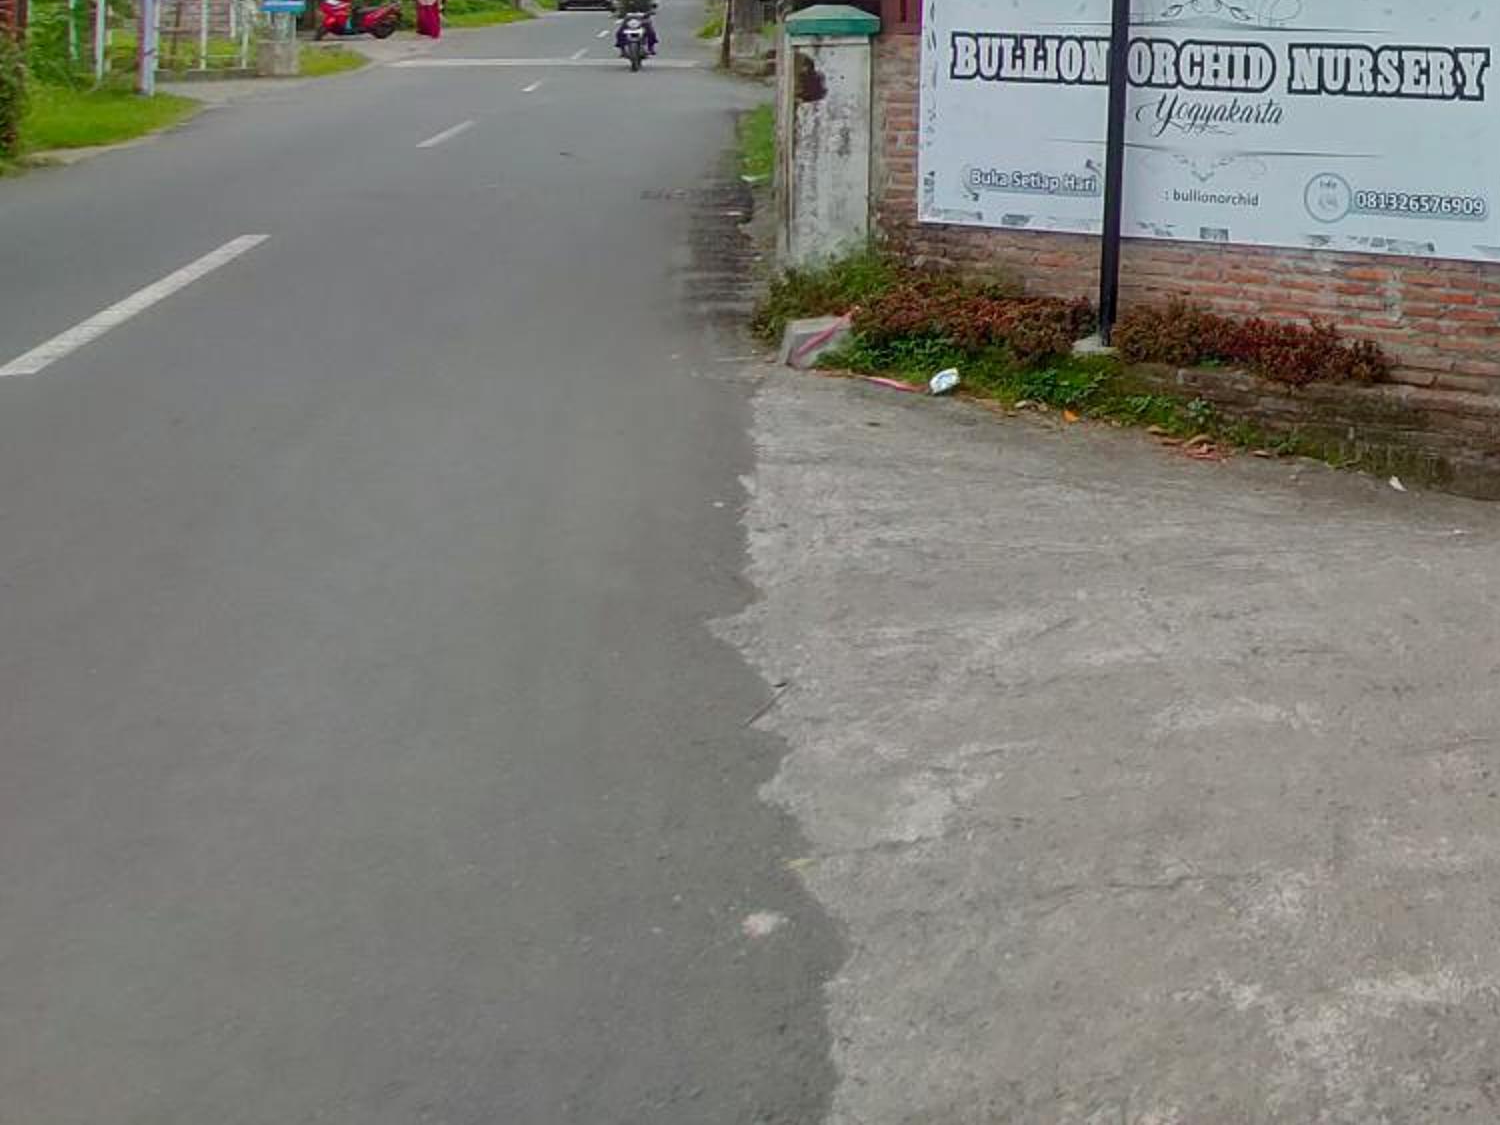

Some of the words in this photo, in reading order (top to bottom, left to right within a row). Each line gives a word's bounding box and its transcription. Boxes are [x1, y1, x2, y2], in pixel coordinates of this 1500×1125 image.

[950, 32, 1110, 85] BULLION
[1126, 38, 1278, 94] ORCHID
[1287, 42, 1491, 102] NURSERY
[1135, 92, 1285, 138] Yogyakarta
[970, 168, 1008, 187] Buka
[1011, 169, 1060, 194] Setiap
[1172, 188, 1260, 207] bullionorchid
[1354, 189, 1488, 217] 081326576909
